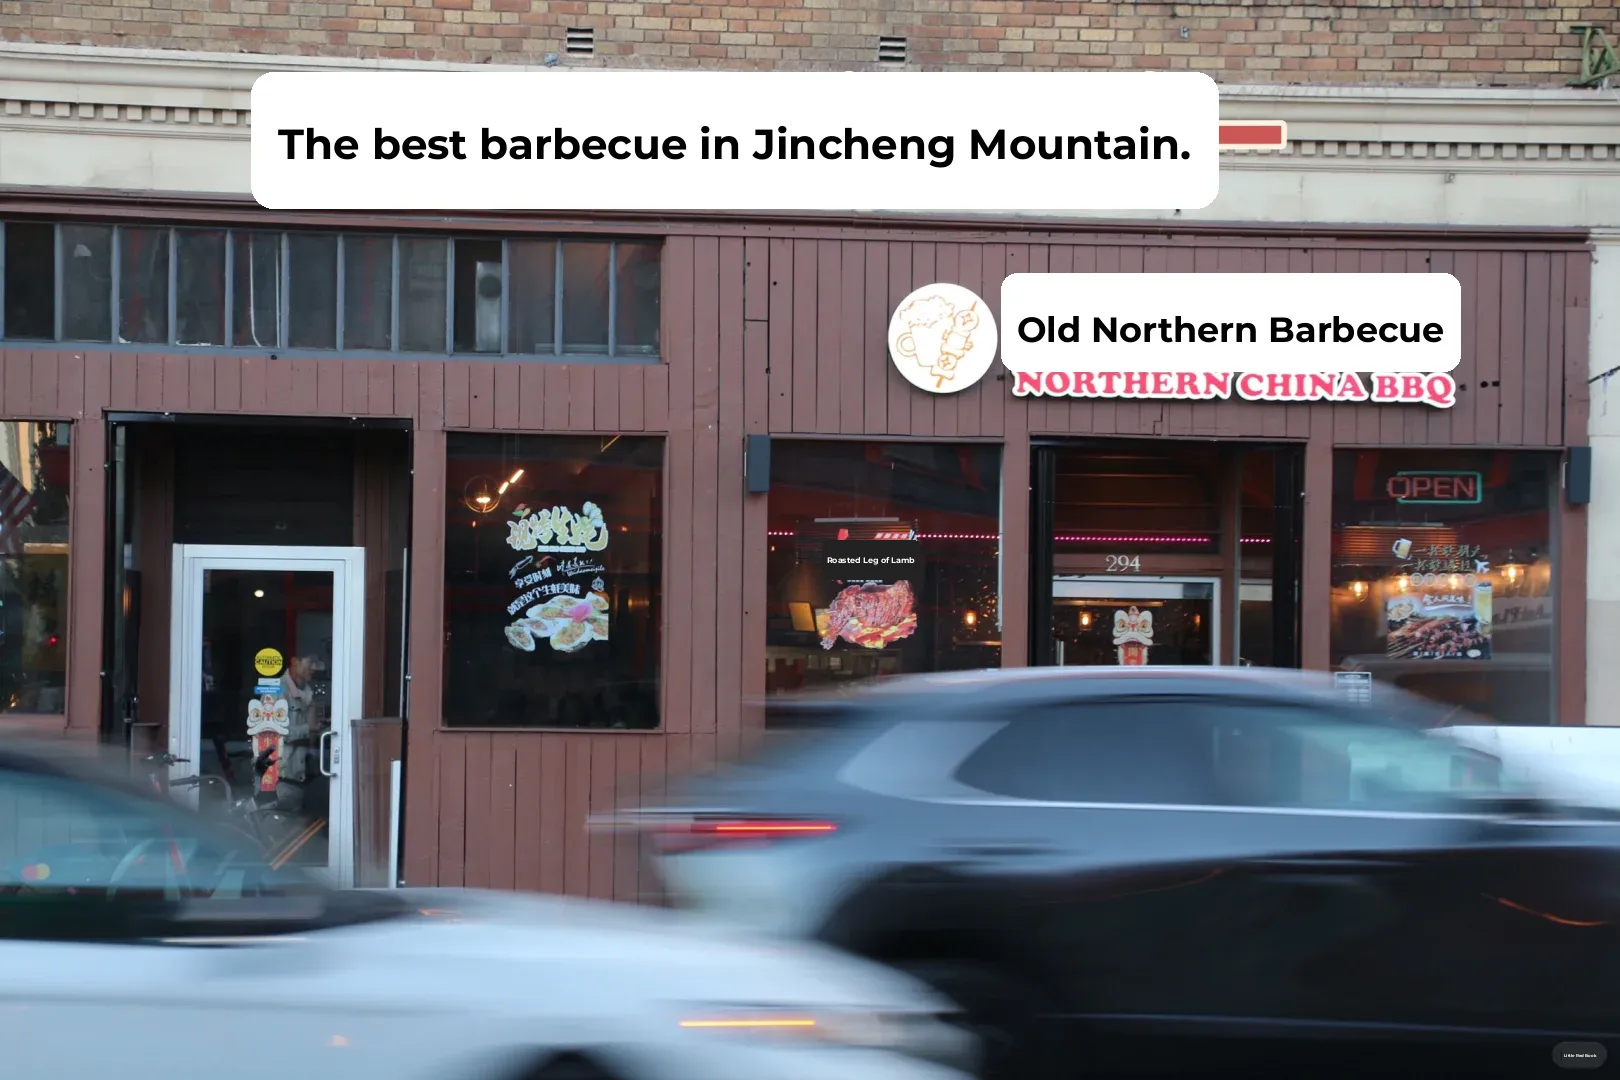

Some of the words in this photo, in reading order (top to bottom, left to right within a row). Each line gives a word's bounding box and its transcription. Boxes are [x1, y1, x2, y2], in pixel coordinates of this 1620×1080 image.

[1014, 371, 1231, 399] NORTHERN
[1239, 372, 1366, 402] CHINA
[1374, 374, 1456, 407] BBQ
[1388, 476, 1475, 499] OPEN
[1105, 554, 1141, 572] 294
